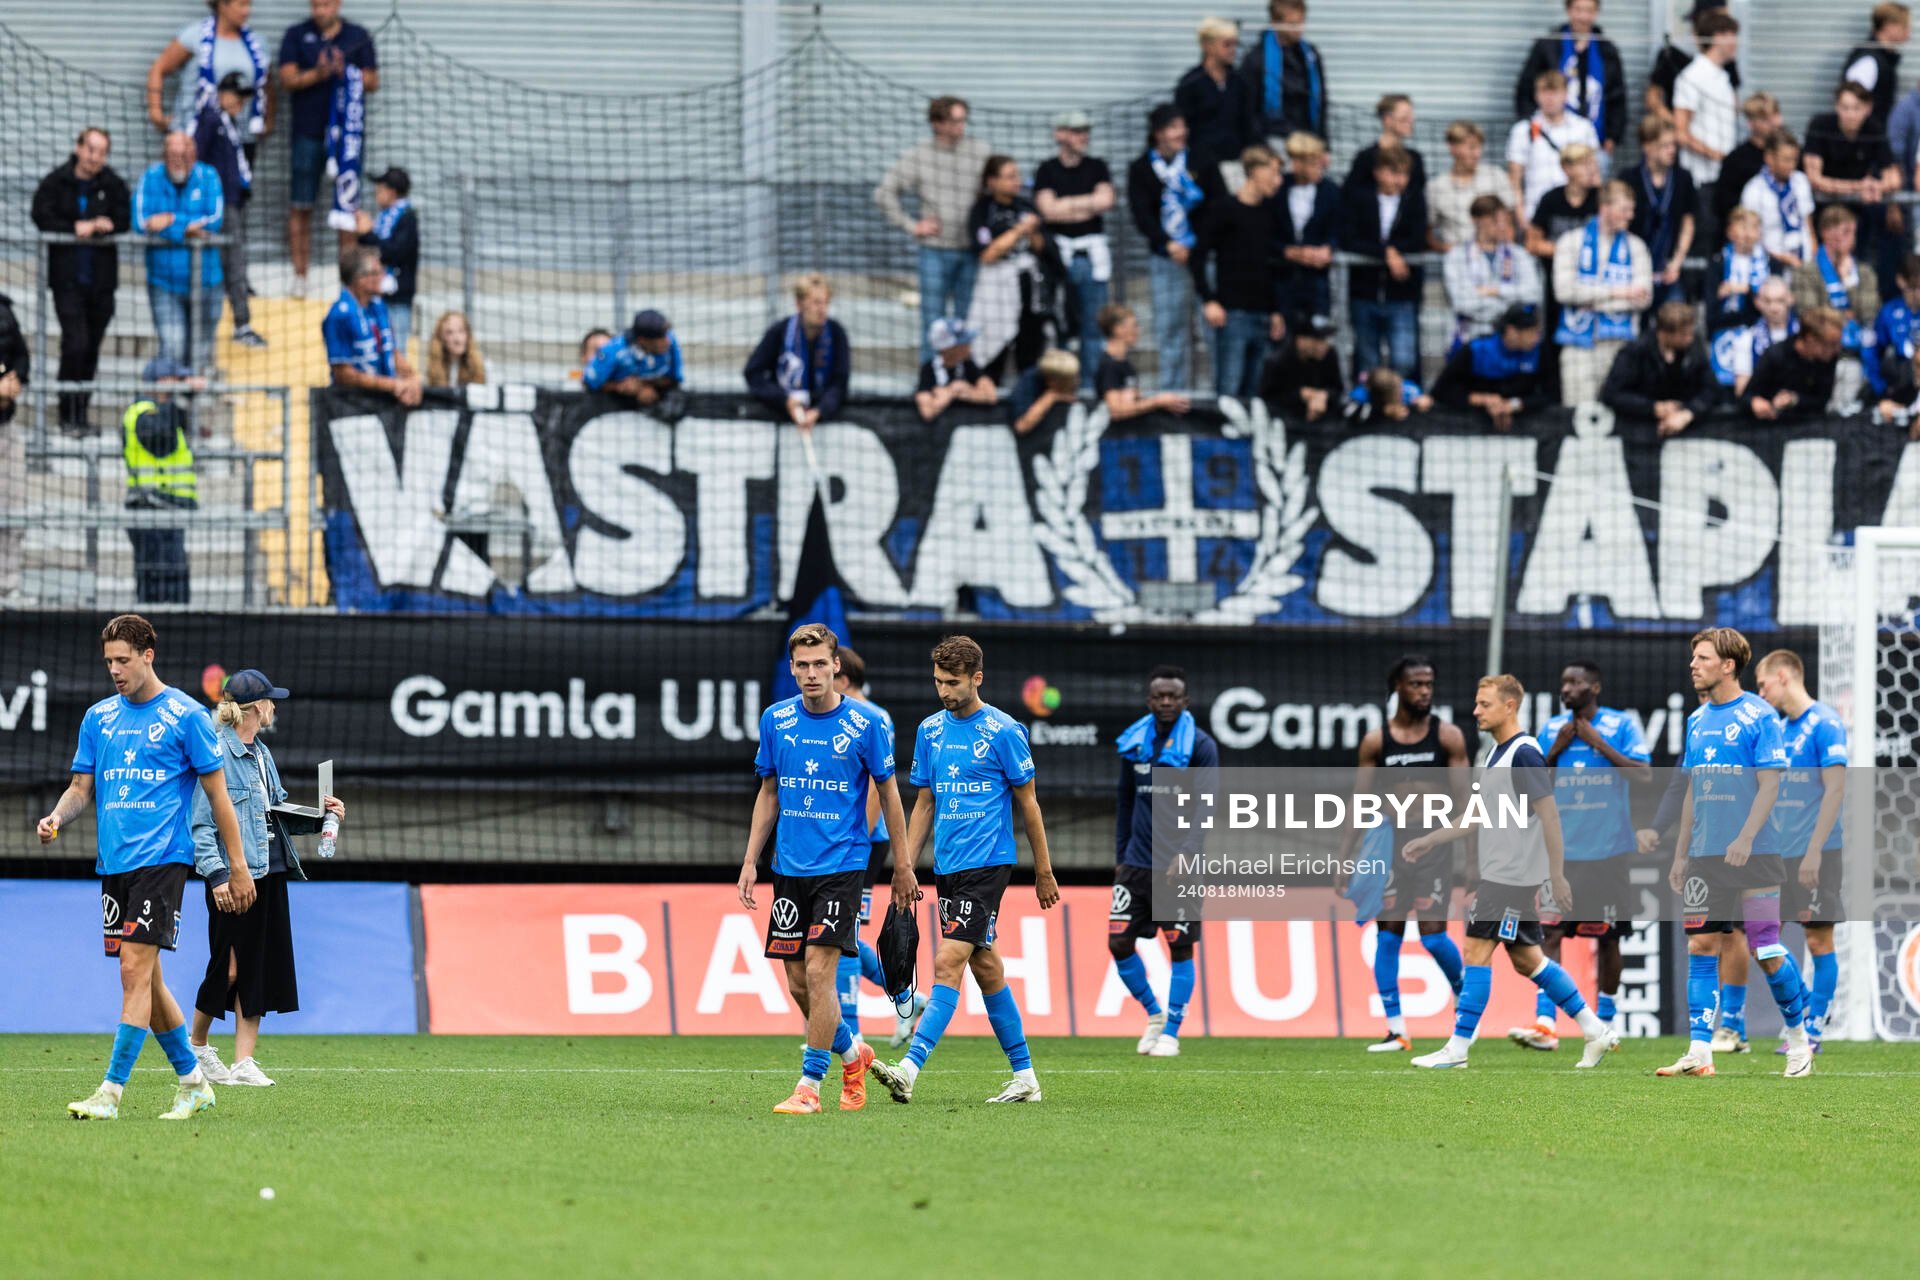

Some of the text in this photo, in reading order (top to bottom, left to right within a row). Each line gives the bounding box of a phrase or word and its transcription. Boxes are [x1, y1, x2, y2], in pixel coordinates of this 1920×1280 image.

[330, 384, 1055, 608] VÄSTRA
[391, 674, 761, 741] Gamla Ull
[104, 768, 167, 781] GETINGE
[780, 777, 849, 792] GETINGE
[936, 781, 993, 793] ETINGE
[142, 900, 151, 915] 3
[827, 901, 840, 916] 11
[960, 900, 972, 915] 19
[563, 913, 1450, 1022] BAHAUS
